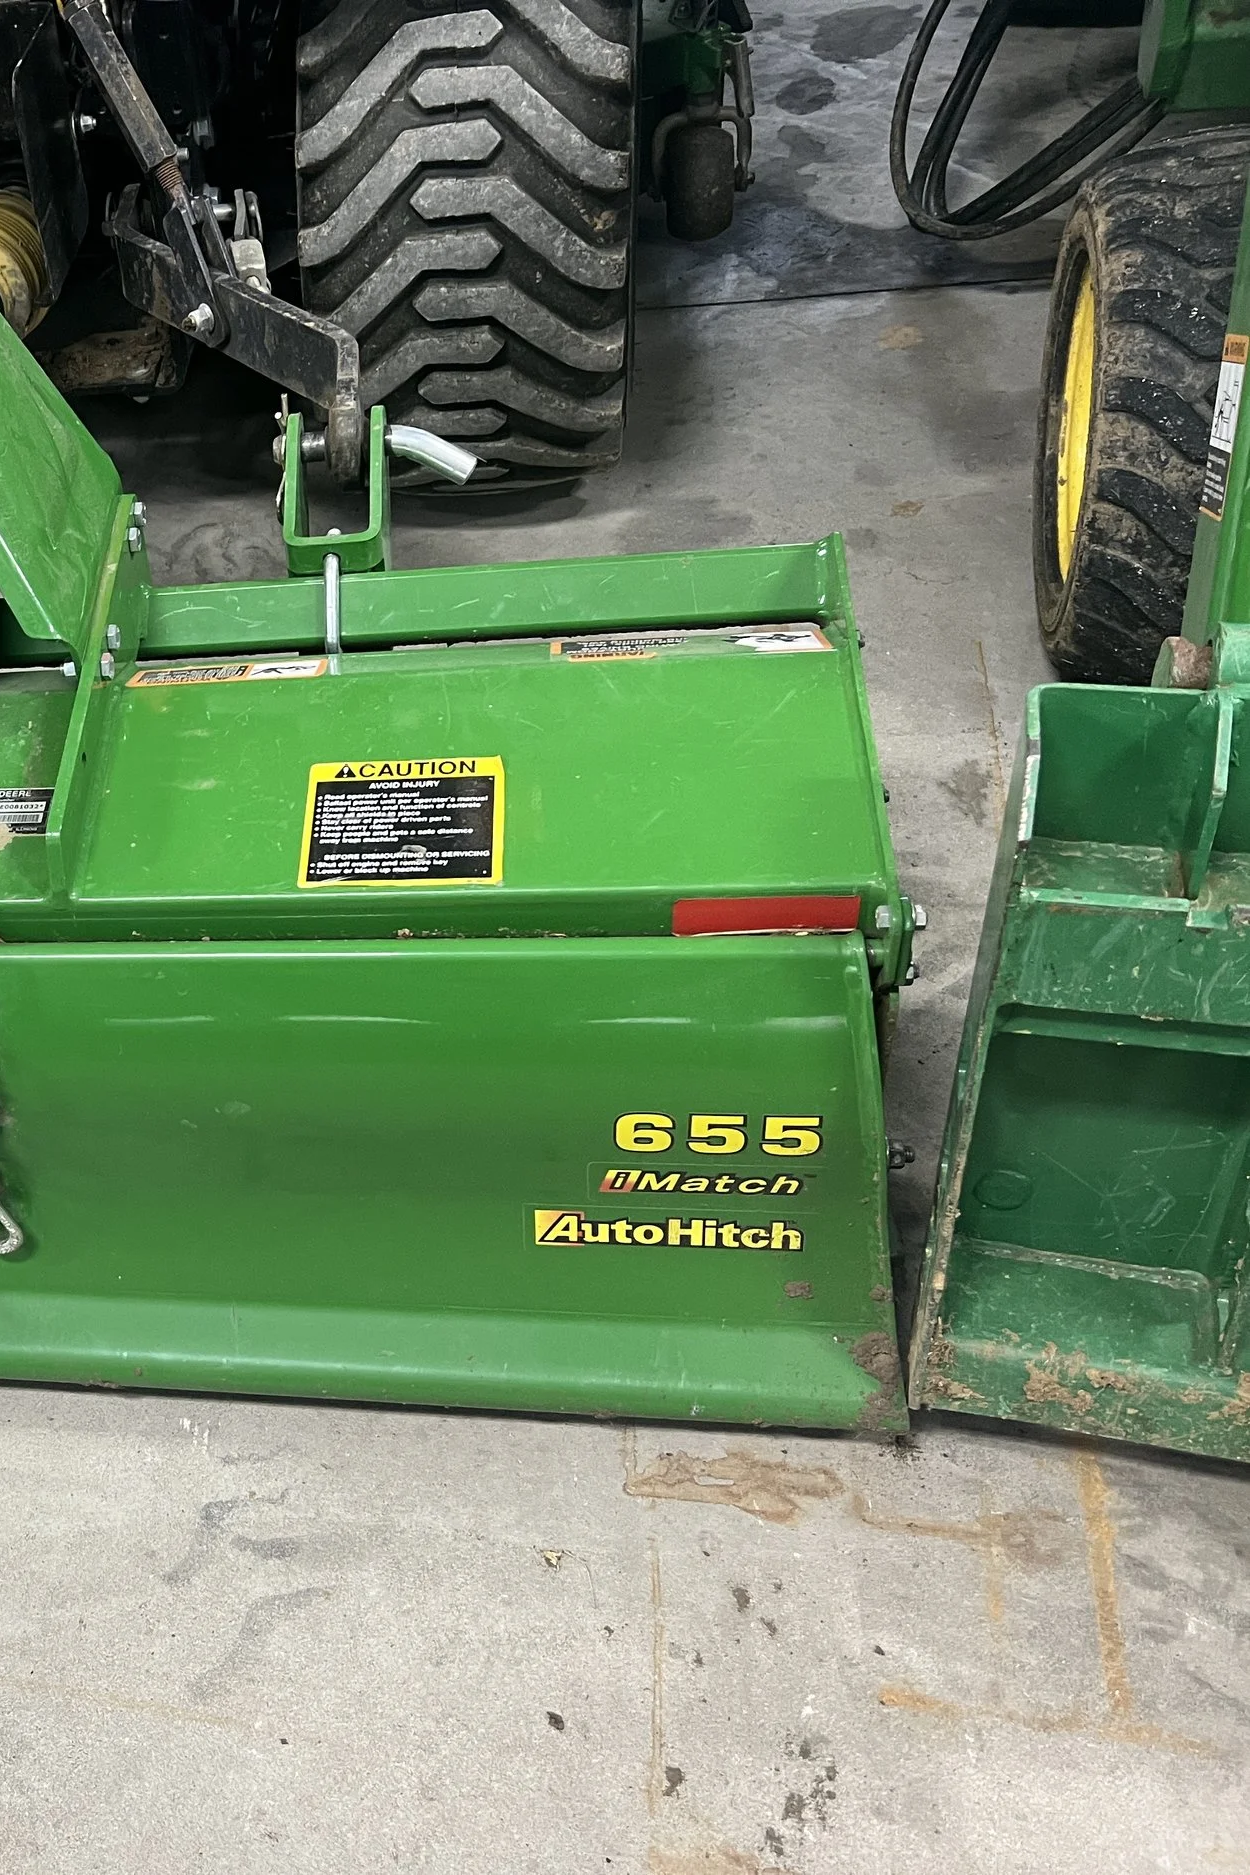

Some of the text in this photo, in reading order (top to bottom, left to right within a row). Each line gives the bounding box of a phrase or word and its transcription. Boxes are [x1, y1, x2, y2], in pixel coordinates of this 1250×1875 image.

[359, 760, 476, 778] CAUTION
[369, 780, 440, 790] AVOID INJURY
[346, 792, 388, 801] operator's
[389, 791, 420, 799] manual
[413, 796, 456, 804] operator's
[373, 817, 400, 825] power
[428, 815, 452, 823] parts
[323, 853, 361, 861] BEFORE
[361, 852, 425, 860] DISMOUNTING
[441, 850, 491, 858] SERVICING
[351, 861, 381, 869] engine
[432, 858, 449, 867] key
[612, 1111, 824, 1156] 655
[598, 1168, 803, 1195] iMatch
[535, 1210, 804, 1251] AutoHitch
